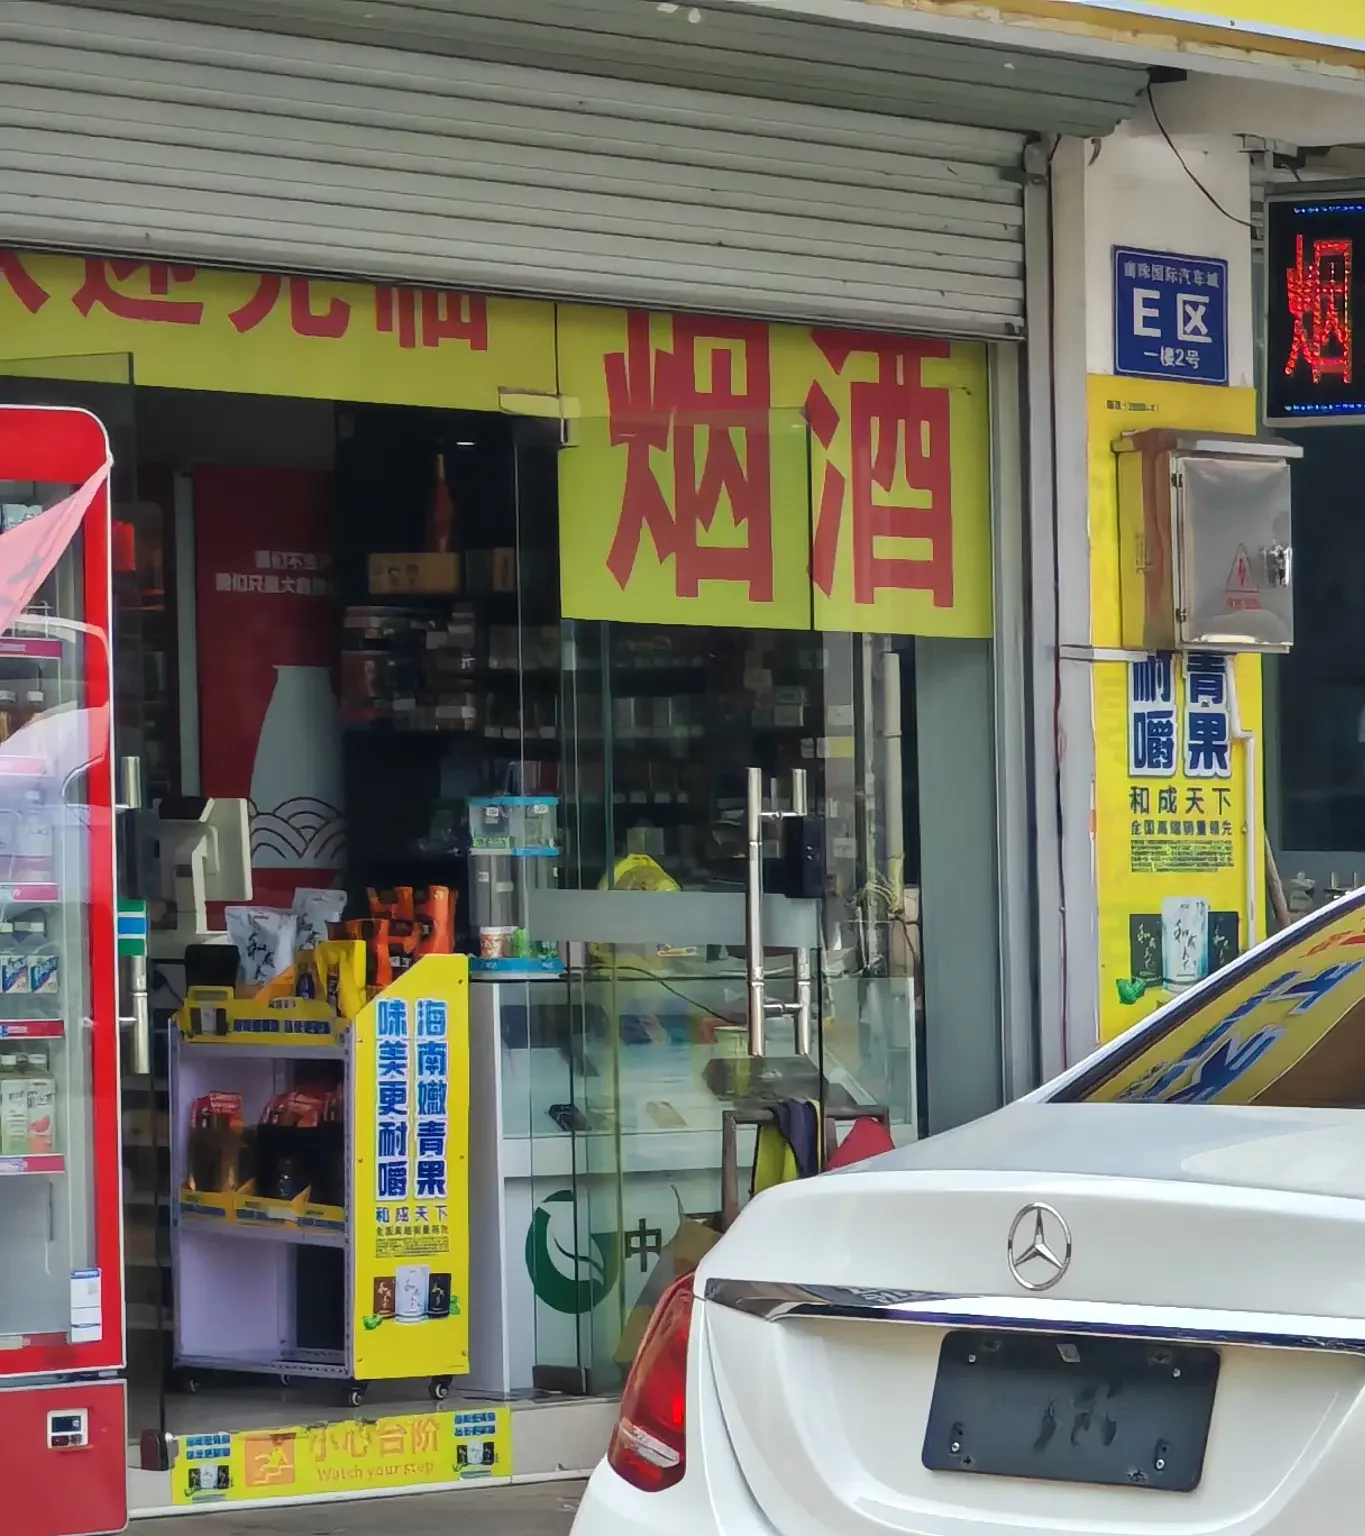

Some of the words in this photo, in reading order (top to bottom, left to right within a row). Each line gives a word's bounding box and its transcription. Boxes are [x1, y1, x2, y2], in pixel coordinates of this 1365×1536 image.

[604, 309, 954, 609] 烟酒
[1130, 786, 1232, 814] 和成天下
[625, 1219, 662, 1273] 中
[309, 1417, 440, 1462] 小心台阶
[317, 1466, 363, 1482] Watch
[367, 1466, 398, 1478] your
